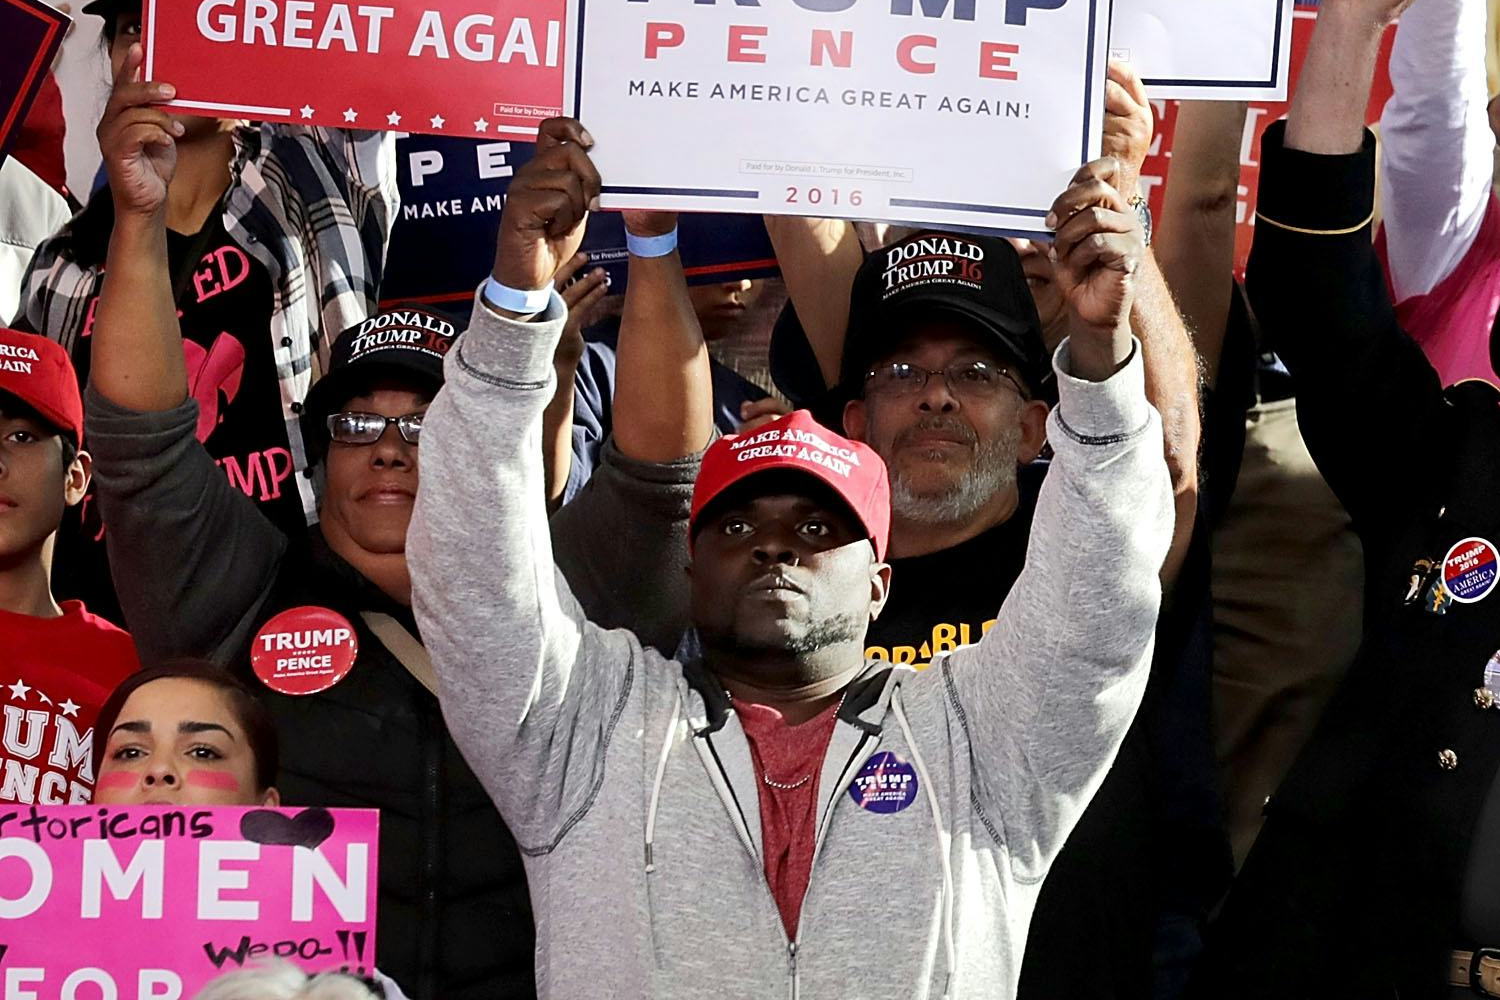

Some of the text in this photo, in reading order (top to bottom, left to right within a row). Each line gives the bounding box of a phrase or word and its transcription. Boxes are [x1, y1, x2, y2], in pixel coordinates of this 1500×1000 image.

[407, 10, 560, 68] AGAI
[643, 22, 1020, 81] PENCE
[628, 79, 1032, 119] MAKE AMERICA GREAT AGAIN!
[524, 108, 532, 116] by
[533, 108, 554, 116] Donald
[786, 187, 862, 206] 2016
[403, 201, 463, 221] MAKE
[886, 238, 984, 270] DONALD
[882, 260, 954, 290] TRUMP
[357, 312, 454, 339] DONALD
[0, 344, 39, 361] RICA
[351, 329, 421, 356] TRUMP
[0, 360, 31, 374] AIN
[730, 428, 860, 466] MAKE AMERICA
[737, 445, 852, 478] GREAT AGAIN
[1447, 545, 1485, 567] TRUMP
[1459, 558, 1479, 571] 2016
[1454, 569, 1495, 593] AMERICA
[260, 629, 350, 651] TRUMP
[277, 655, 331, 671] PENCE
[855, 775, 912, 785] TRUMP
[0, 808, 214, 844] rtoricans
[0, 837, 369, 922] OMEN
